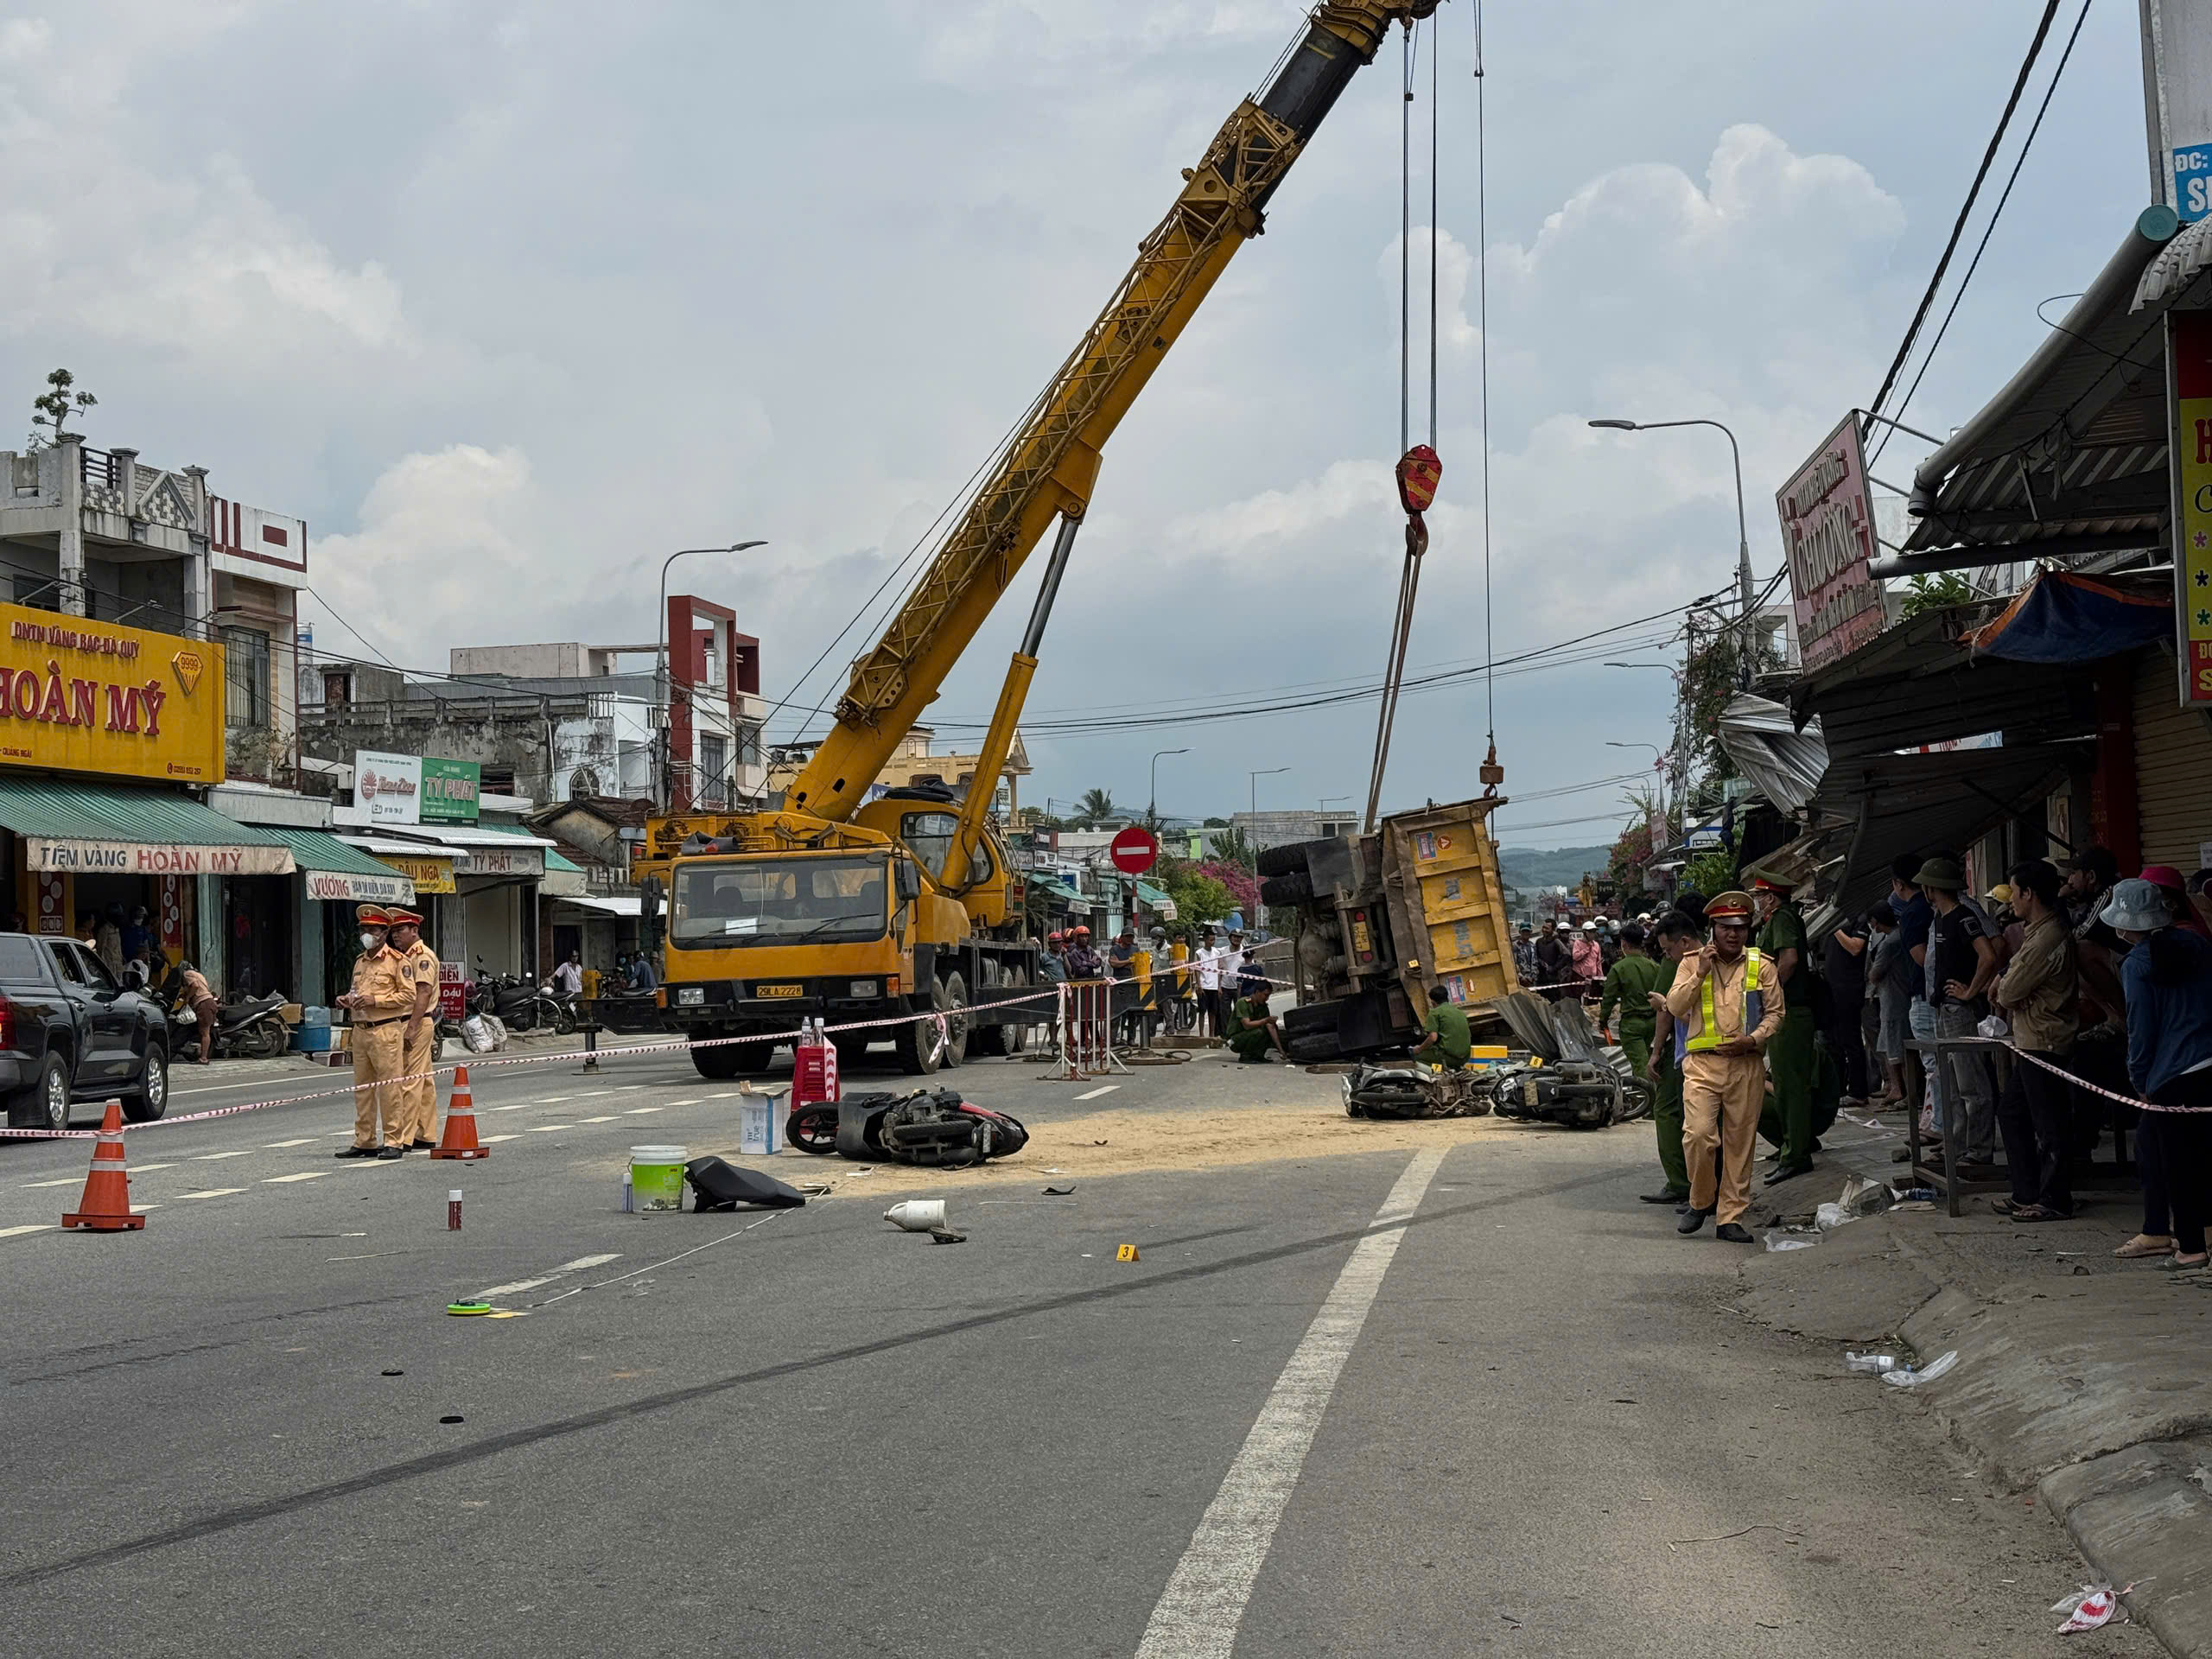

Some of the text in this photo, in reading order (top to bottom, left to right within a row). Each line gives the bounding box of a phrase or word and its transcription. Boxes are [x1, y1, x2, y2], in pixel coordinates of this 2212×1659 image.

[47, 626, 78, 648] VÀNG
[181, 657, 199, 671] 9999
[105, 679, 166, 734] MỸ
[444, 774, 478, 803] PHÁT
[84, 844, 127, 867] VÀNG
[137, 845, 200, 871] HOÀN
[211, 848, 242, 871] MỸ
[488, 850, 512, 872] PHÁT
[421, 864, 439, 880] NGA
[1122, 1246, 1129, 1258] 3
